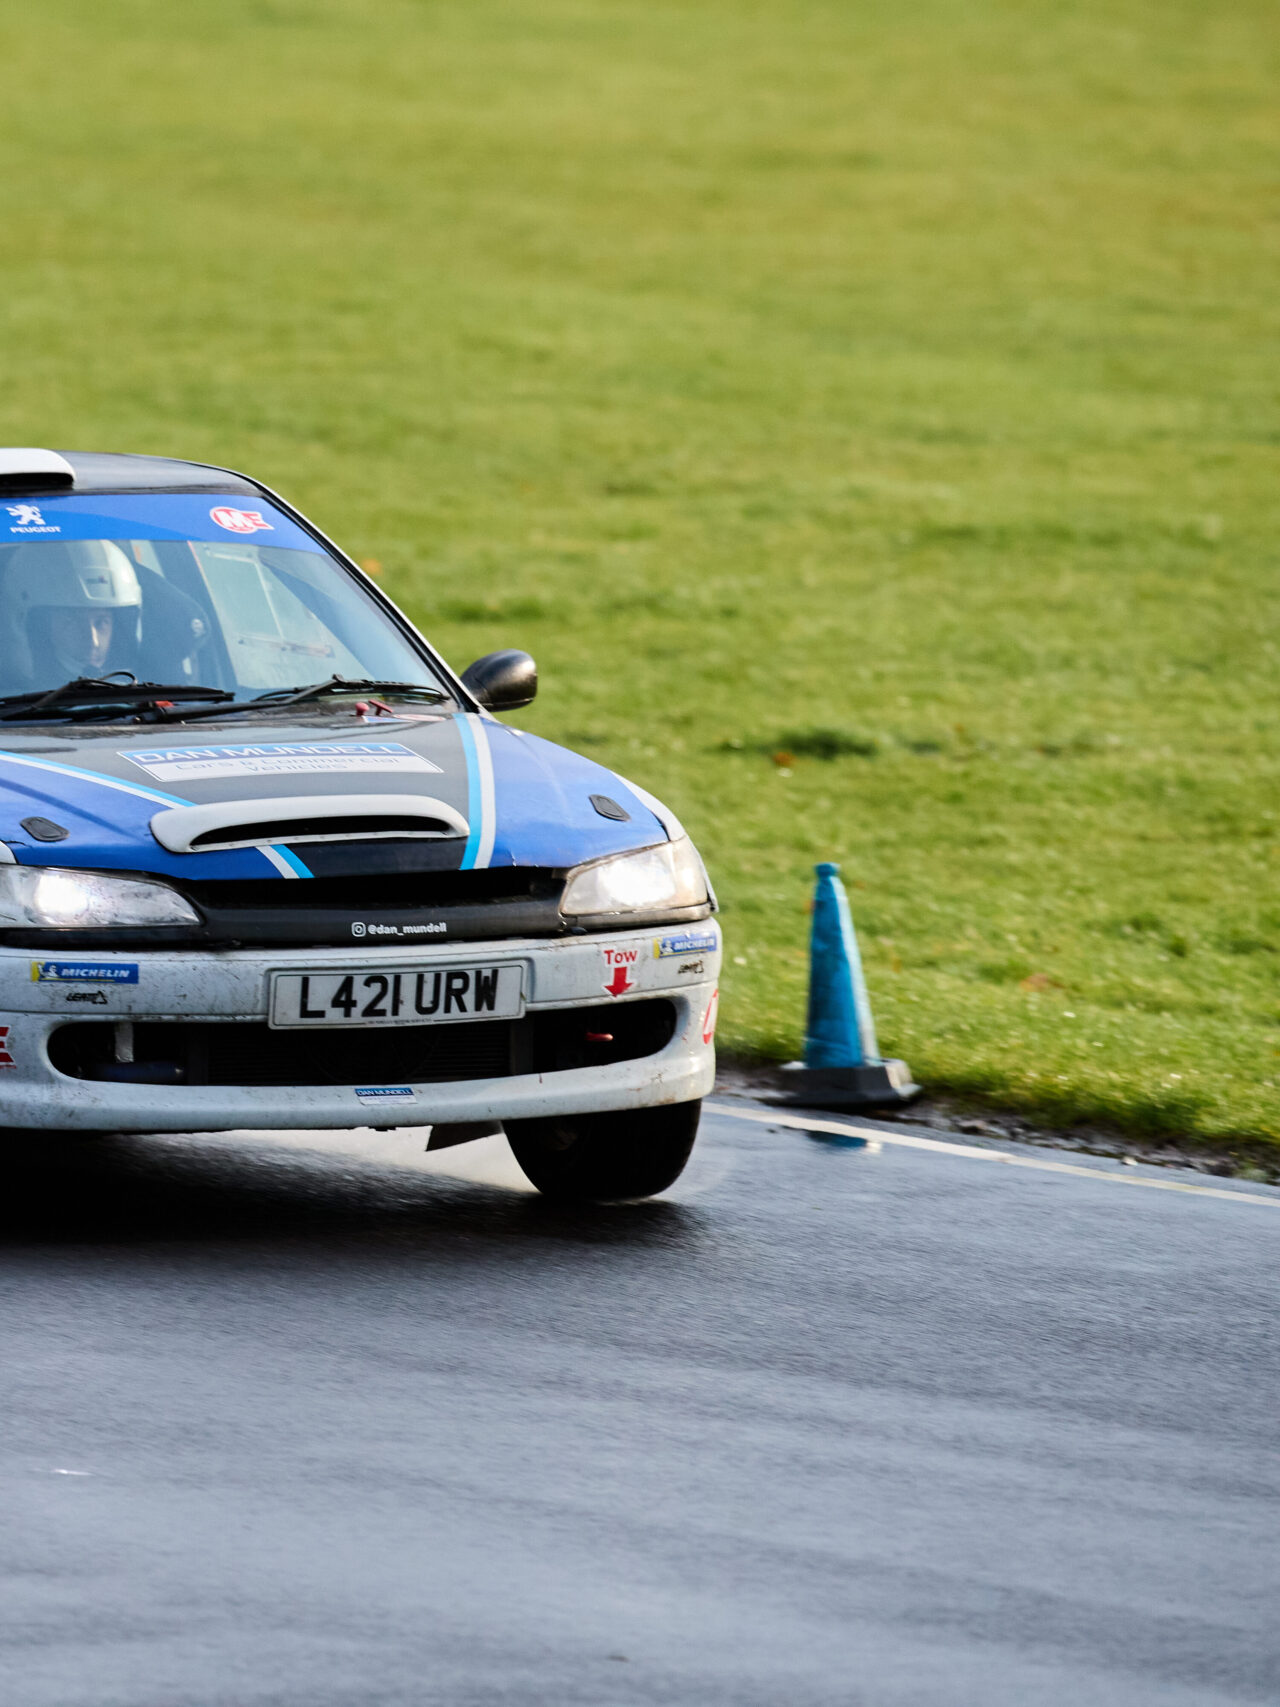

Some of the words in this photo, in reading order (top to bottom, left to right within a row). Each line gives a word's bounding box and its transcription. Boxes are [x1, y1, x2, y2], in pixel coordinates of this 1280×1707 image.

[132, 752, 219, 763] DAN
[223, 746, 410, 757] MUNDELL
[368, 922, 447, 936] @dan_mundell
[61, 968, 131, 978] MICHELIN
[414, 968, 499, 1015] URW
